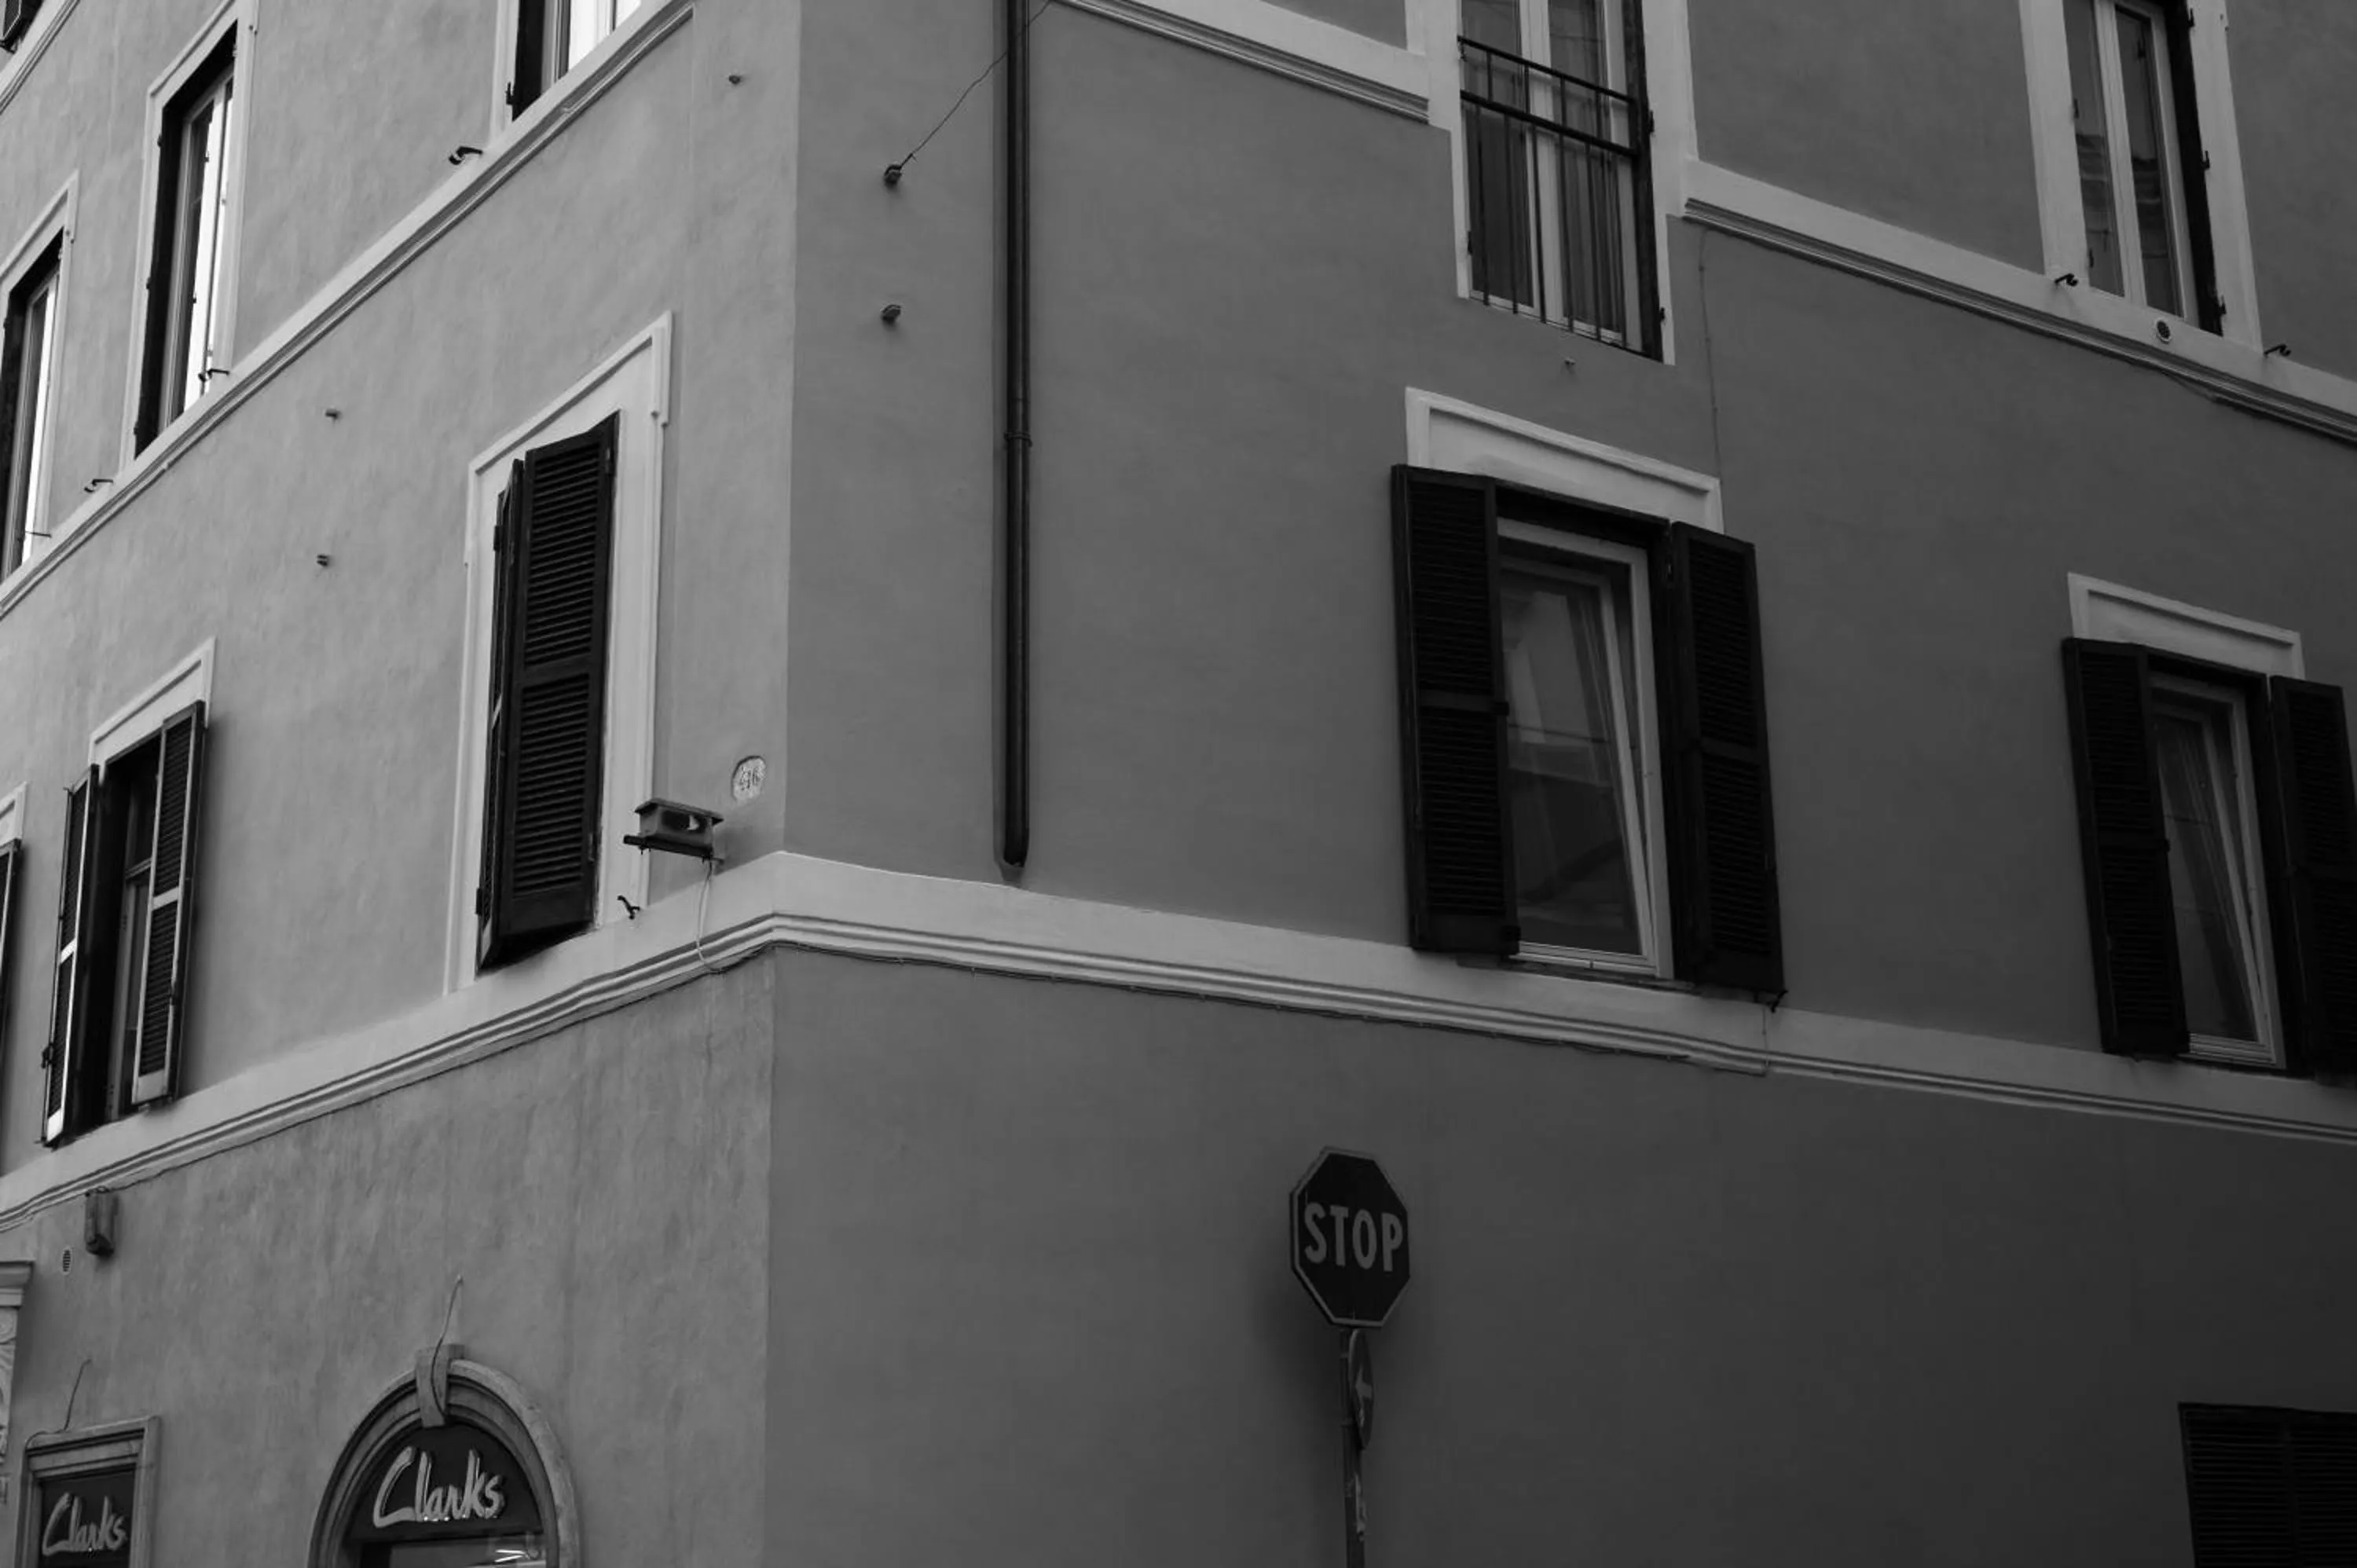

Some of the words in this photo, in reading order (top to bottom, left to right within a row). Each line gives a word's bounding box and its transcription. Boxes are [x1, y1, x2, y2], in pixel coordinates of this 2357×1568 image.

[1303, 1201, 1403, 1273] STOP
[372, 1445, 505, 1529] Clarks
[42, 1492, 128, 1556] Clarks
